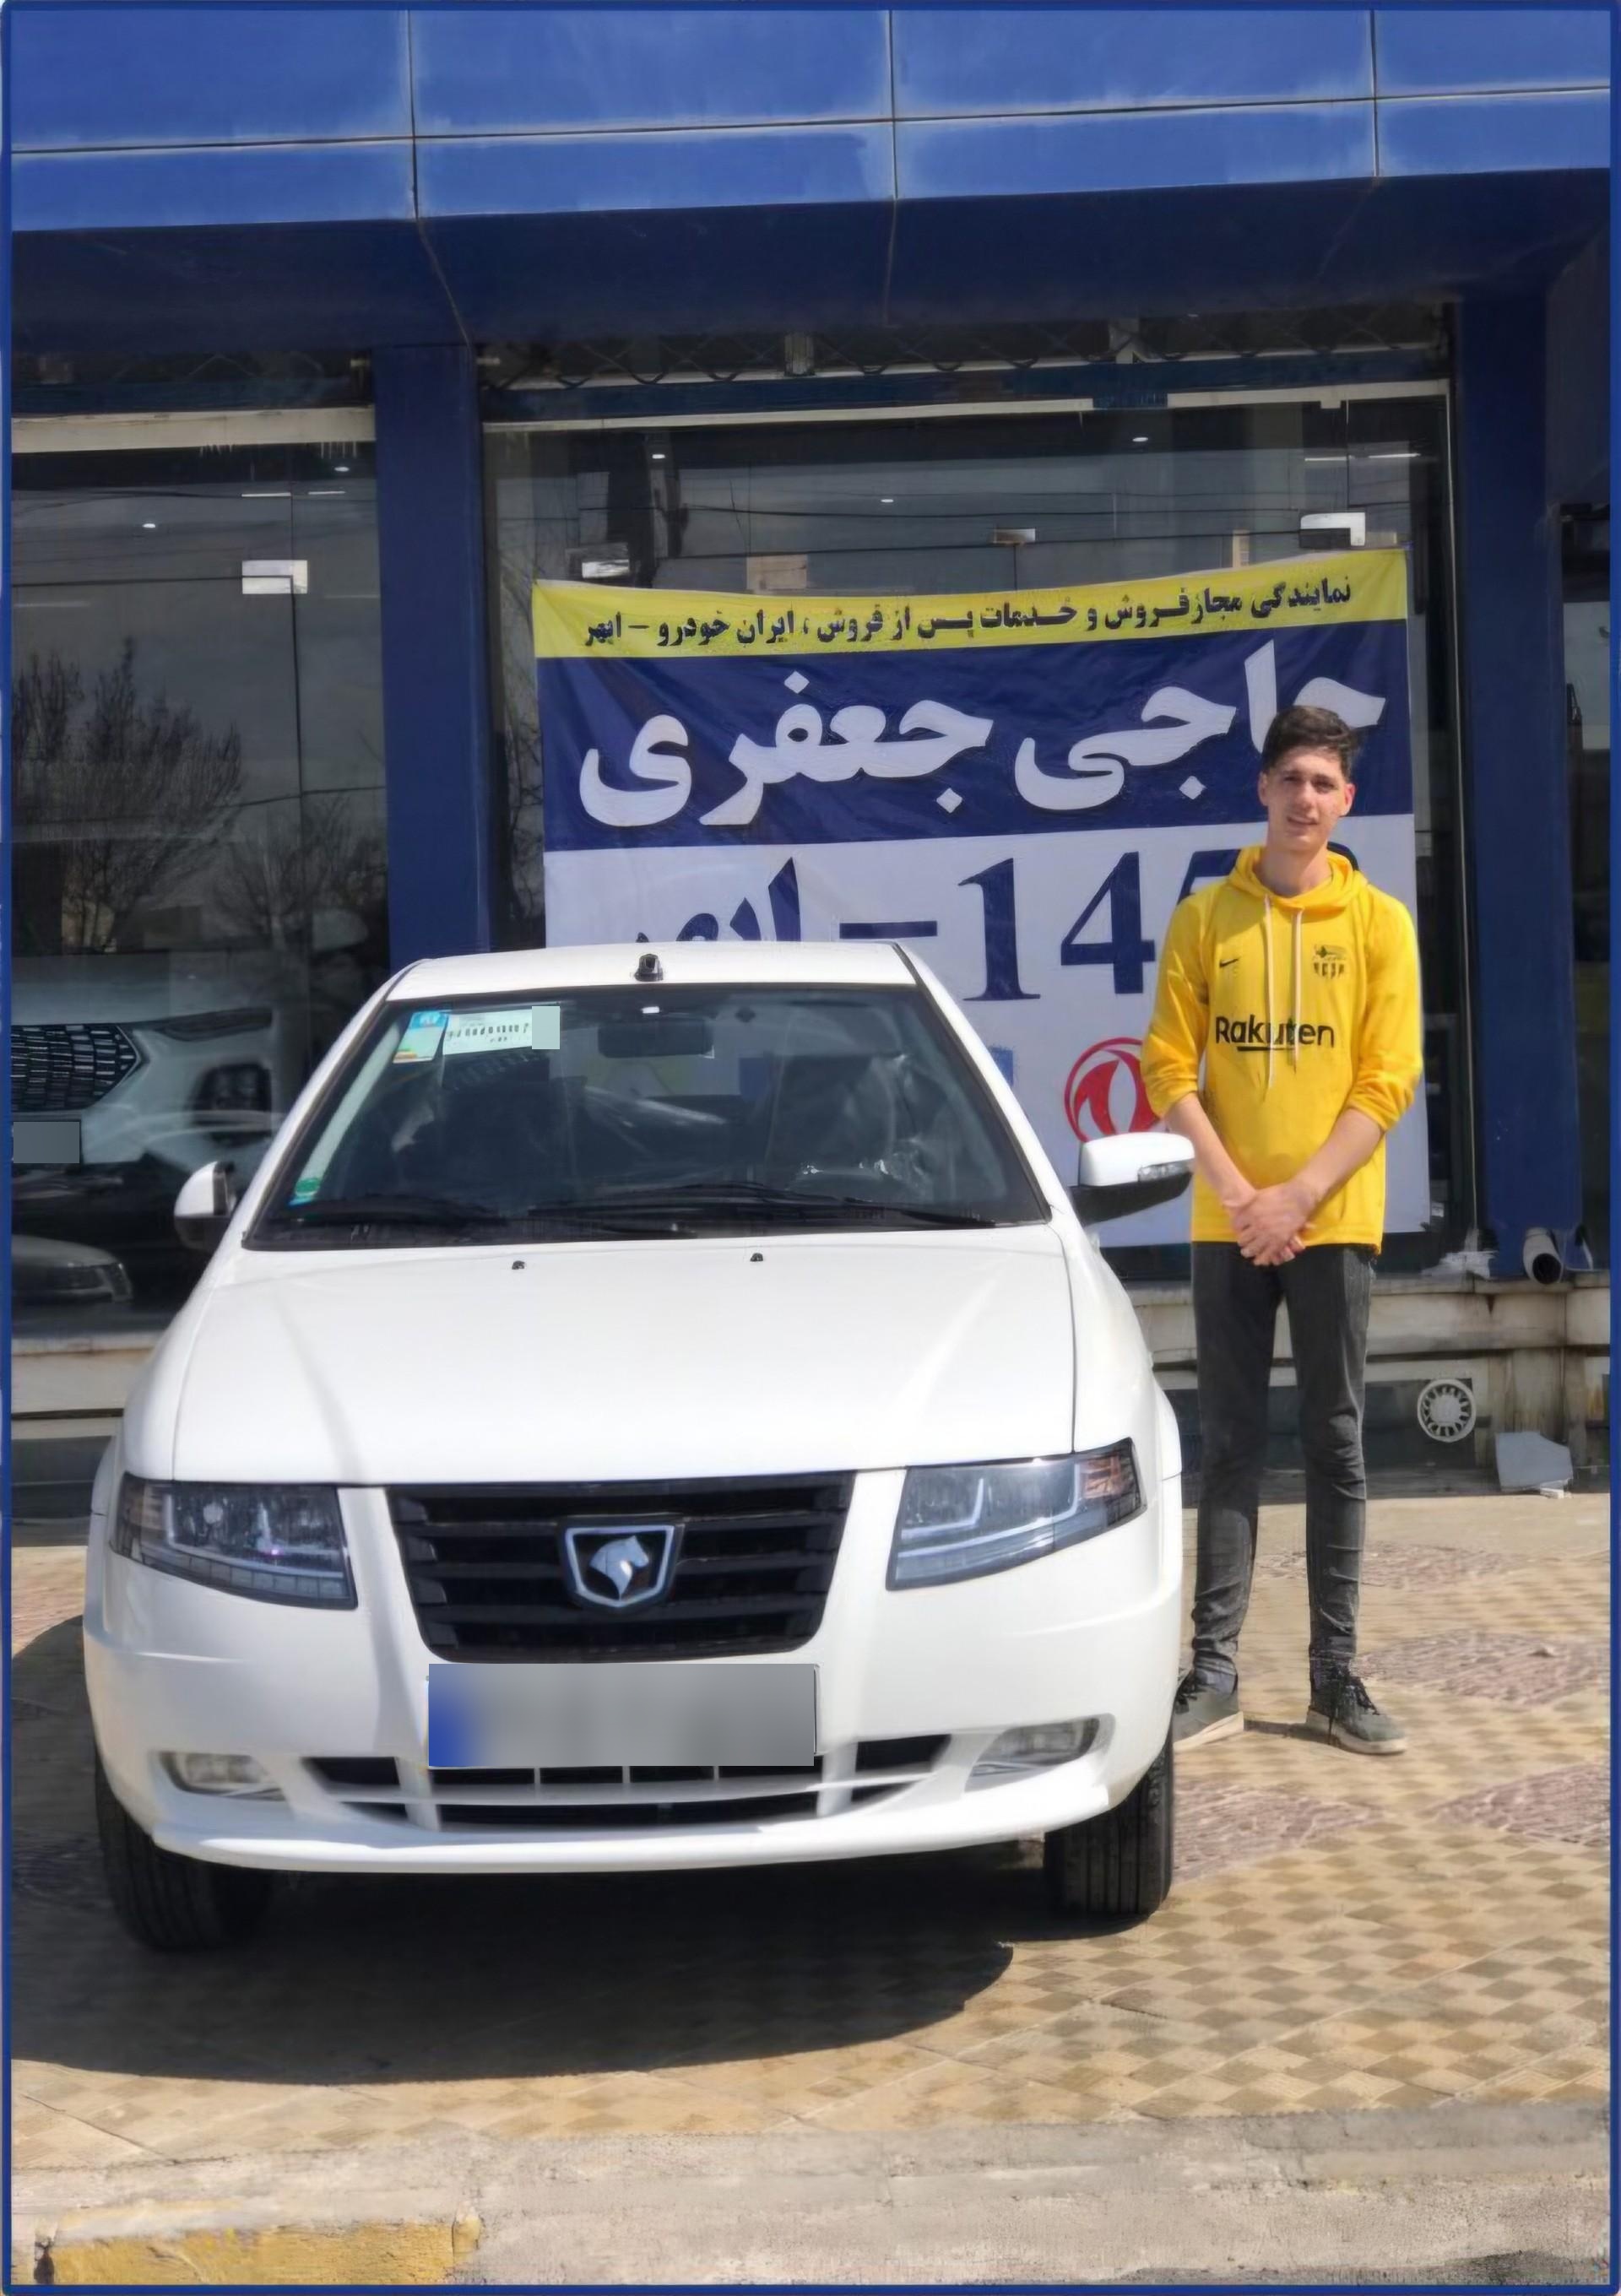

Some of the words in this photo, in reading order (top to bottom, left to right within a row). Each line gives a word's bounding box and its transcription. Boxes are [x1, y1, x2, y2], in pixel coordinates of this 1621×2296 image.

[979, 597, 1078, 629] خدمات
[1104, 587, 1190, 631] فروش
[1190, 588, 1244, 625] مجاز
[1250, 576, 1352, 620] نمایندگی
[656, 609, 730, 647] خودرو
[736, 609, 794, 645] ایران
[890, 604, 911, 642] از
[917, 609, 974, 640] پس
[1086, 608, 1098, 632] و
[579, 671, 993, 827] جعفری
[1215, 1014, 1335, 1048] Rakuten
